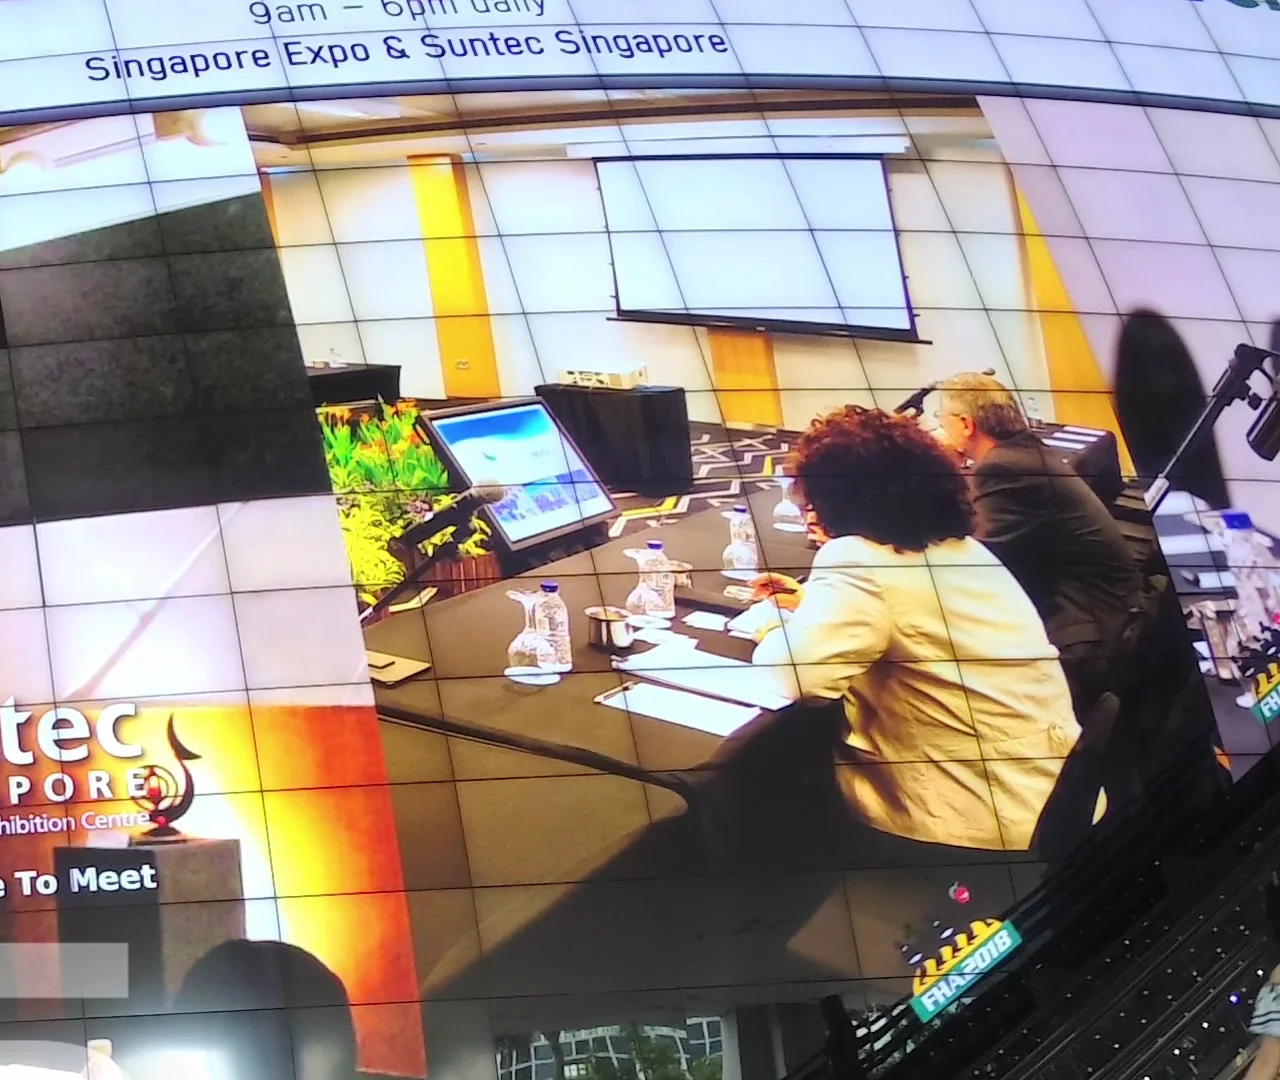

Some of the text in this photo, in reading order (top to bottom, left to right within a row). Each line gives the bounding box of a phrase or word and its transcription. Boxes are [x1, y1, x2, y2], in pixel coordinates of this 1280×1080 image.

[249, 1, 328, 24] 9am
[383, 0, 458, 21] 6pm
[85, 29, 728, 81] Singapore Expo & Suntec Singapore
[81, 810, 151, 830] Centre
[15, 870, 58, 895] To
[71, 863, 158, 892] Meet
[919, 929, 1013, 1012] FHA2018
